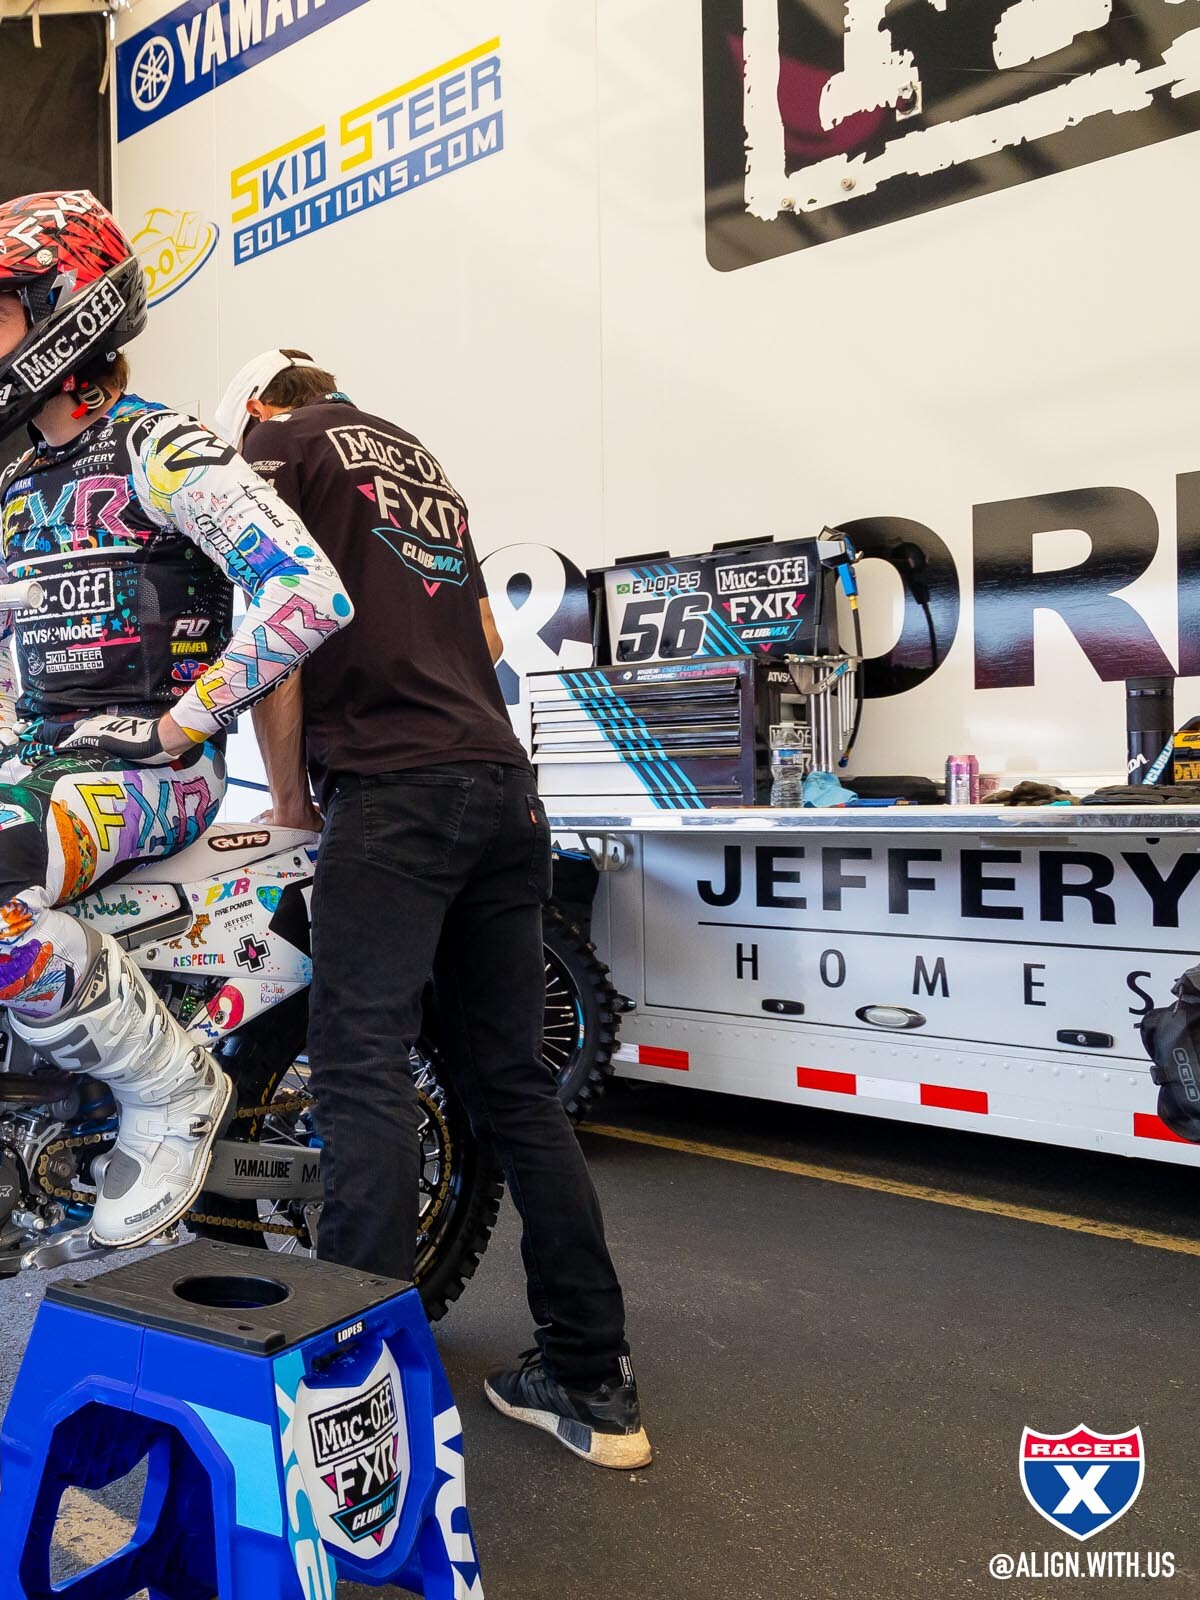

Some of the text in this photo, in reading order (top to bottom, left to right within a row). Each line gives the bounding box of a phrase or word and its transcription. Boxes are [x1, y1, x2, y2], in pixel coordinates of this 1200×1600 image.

[176, 0, 326, 85] YAMA
[231, 36, 502, 223] SKID STEER
[239, 125, 500, 257] SOLUTIONS.COM
[22, 283, 121, 385] Muc-Off
[72, 453, 115, 468] JEFFERY
[340, 432, 447, 485] Muc-O
[3, 474, 138, 559] FXR
[402, 541, 462, 574] CLUBMX
[720, 562, 803, 591] Muc-Off
[616, 592, 712, 663] 56
[730, 591, 798, 622] FXR
[46, 647, 103, 664] SKID STEER
[211, 833, 268, 849] GUTS
[205, 877, 250, 906] FXR
[697, 845, 1200, 928] JEFFERY
[223, 913, 254, 928] JEFFERY
[173, 953, 225, 967] RESPECTFUL
[736, 943, 1155, 1016] HOMES
[234, 1159, 293, 1178] YAMALUBE
[338, 1322, 363, 1342] LOPES
[318, 1386, 394, 1455] Muc-Off
[334, 1437, 397, 1505] FXR
